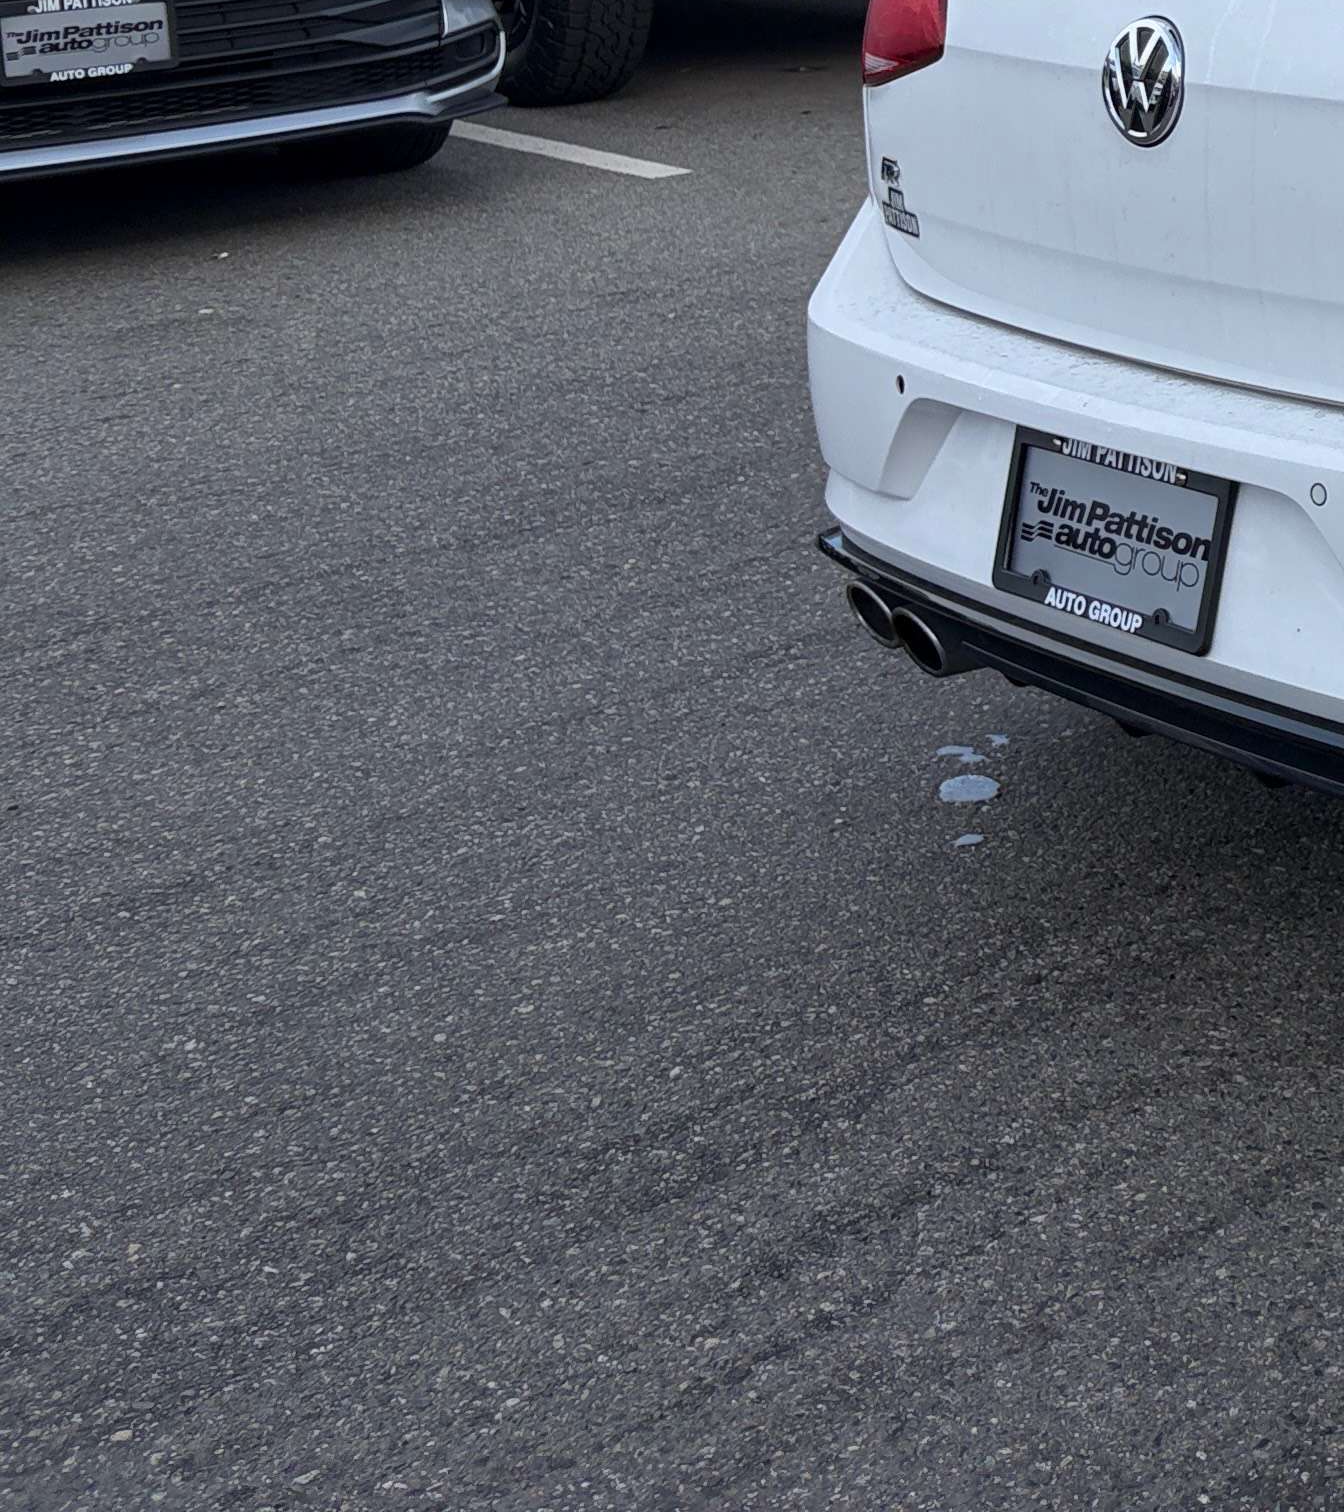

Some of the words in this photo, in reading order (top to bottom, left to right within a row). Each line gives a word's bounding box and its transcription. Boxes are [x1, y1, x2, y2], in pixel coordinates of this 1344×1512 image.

[50, 69, 86, 82] AUTO
[87, 63, 133, 79] GROUP
[1061, 439, 1092, 461] JIM
[1095, 444, 1178, 484] PATTISON
[1030, 481, 1049, 498] The
[1044, 586, 1087, 616] AUTO
[1088, 600, 1144, 634] GROUP
